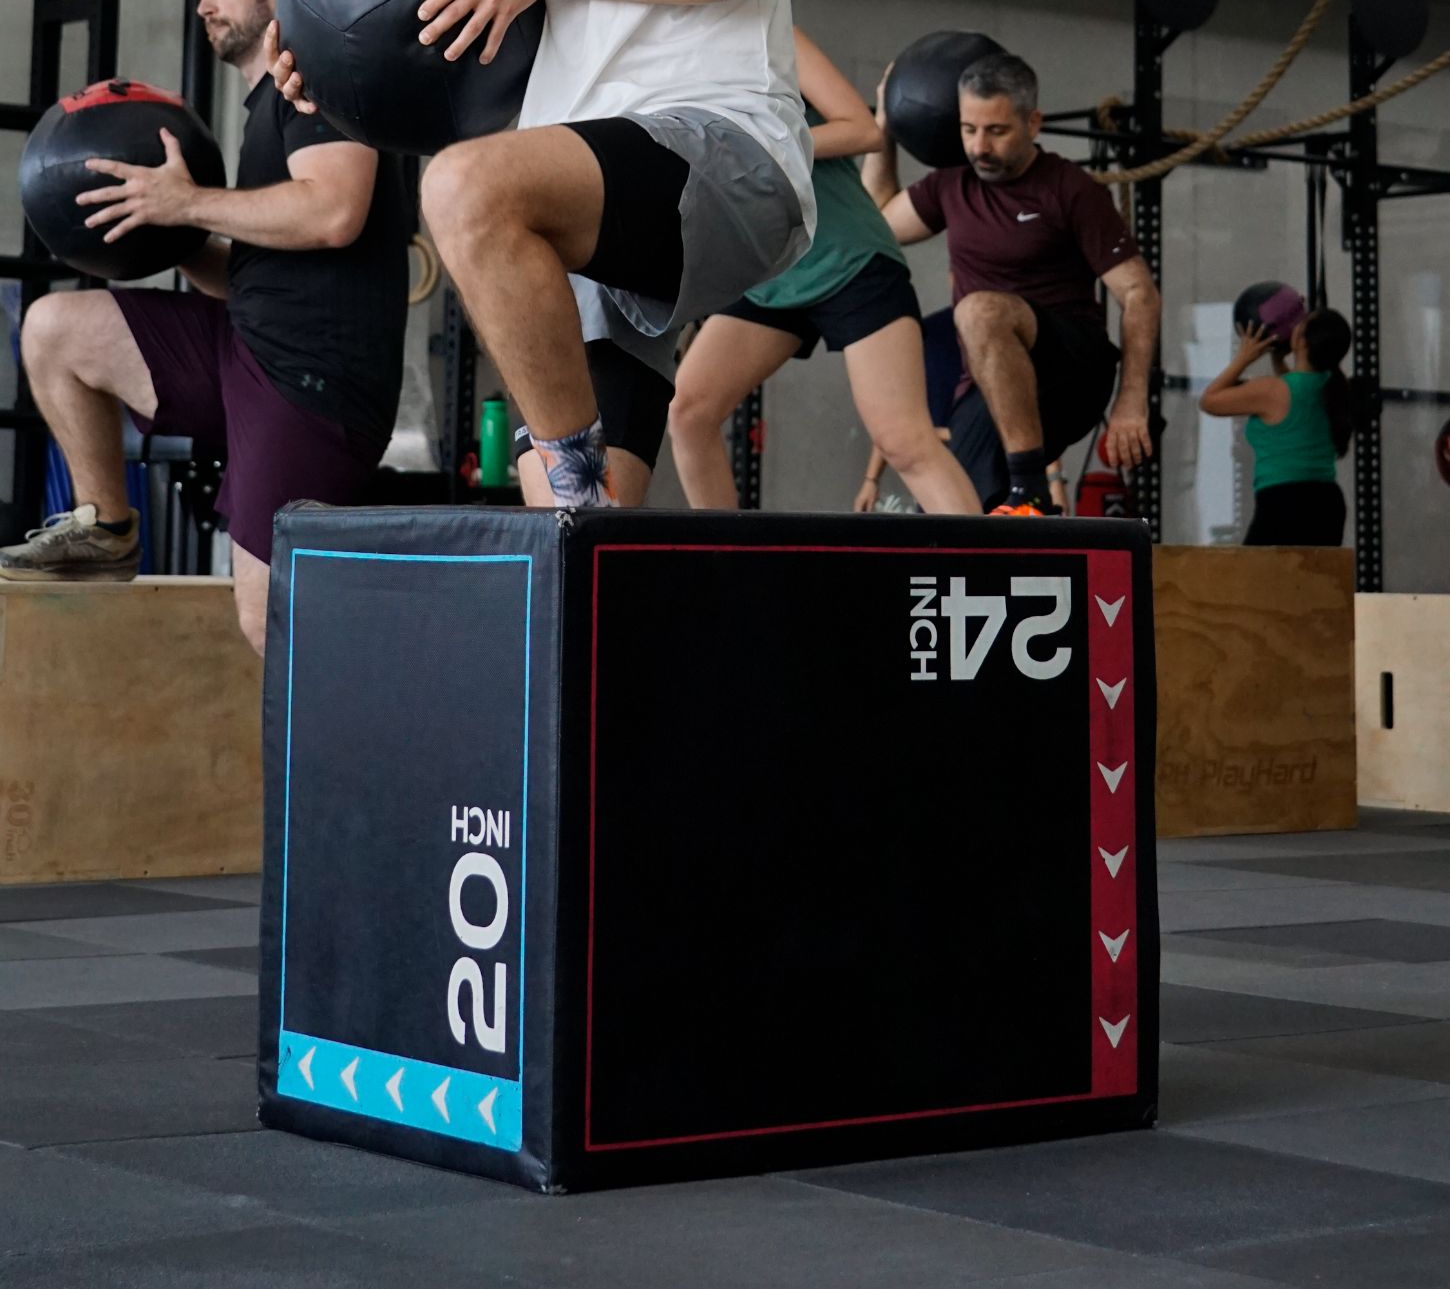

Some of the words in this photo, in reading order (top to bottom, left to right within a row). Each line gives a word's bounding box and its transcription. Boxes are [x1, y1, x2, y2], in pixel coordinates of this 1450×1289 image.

[909, 576, 938, 681] INCH
[940, 576, 1073, 681] 24
[451, 805, 511, 849] INCH
[1200, 754, 1318, 795] PlayHard
[447, 851, 509, 1054] 20
